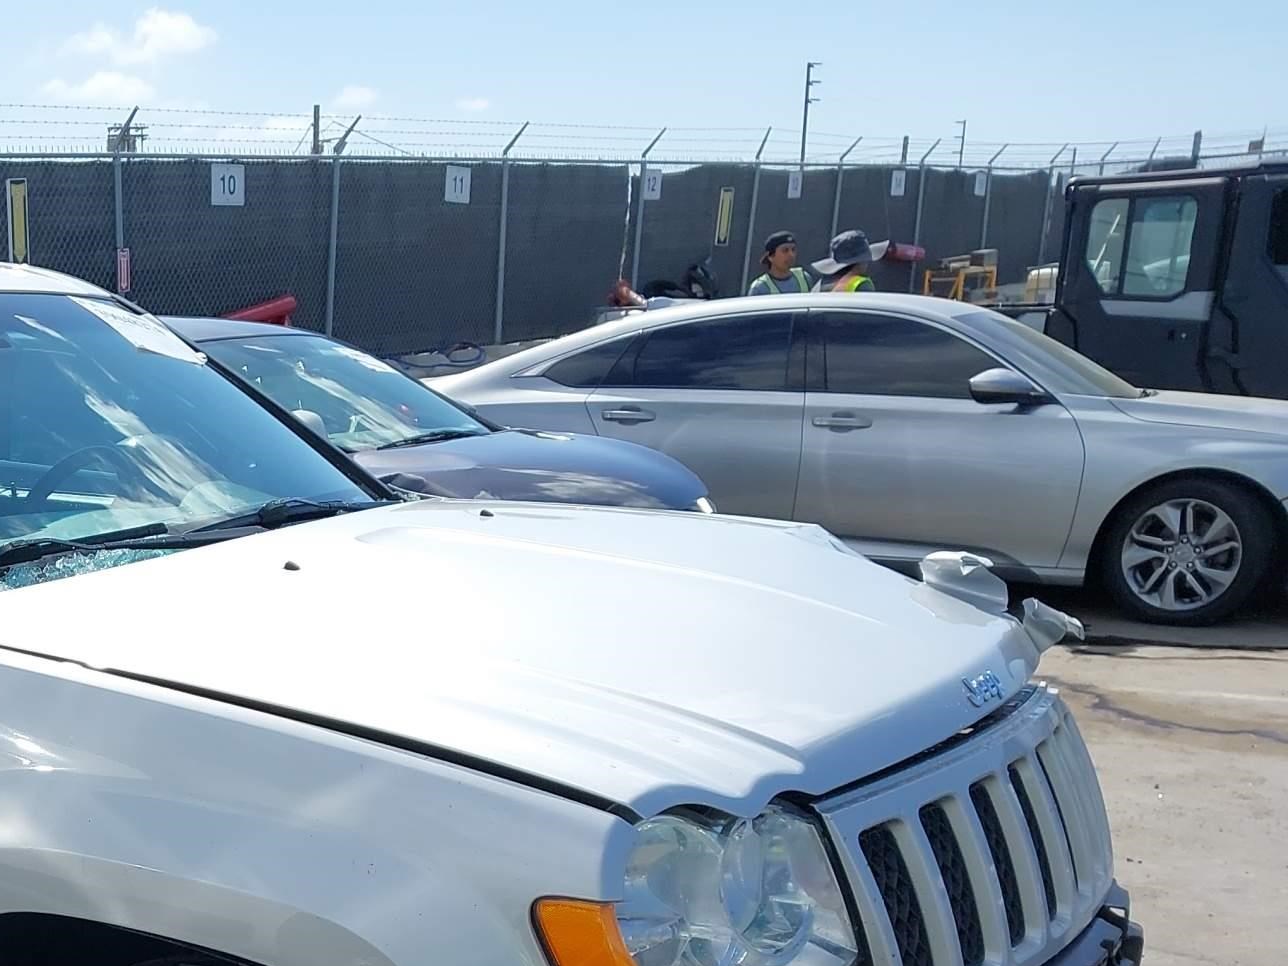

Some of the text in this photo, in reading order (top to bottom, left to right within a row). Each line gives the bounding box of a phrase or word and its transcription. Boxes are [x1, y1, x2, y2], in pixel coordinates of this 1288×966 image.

[219, 175, 237, 196] 10
[452, 175, 465, 194] 11
[647, 175, 657, 192] 12
[961, 670, 1002, 708] Jeep
